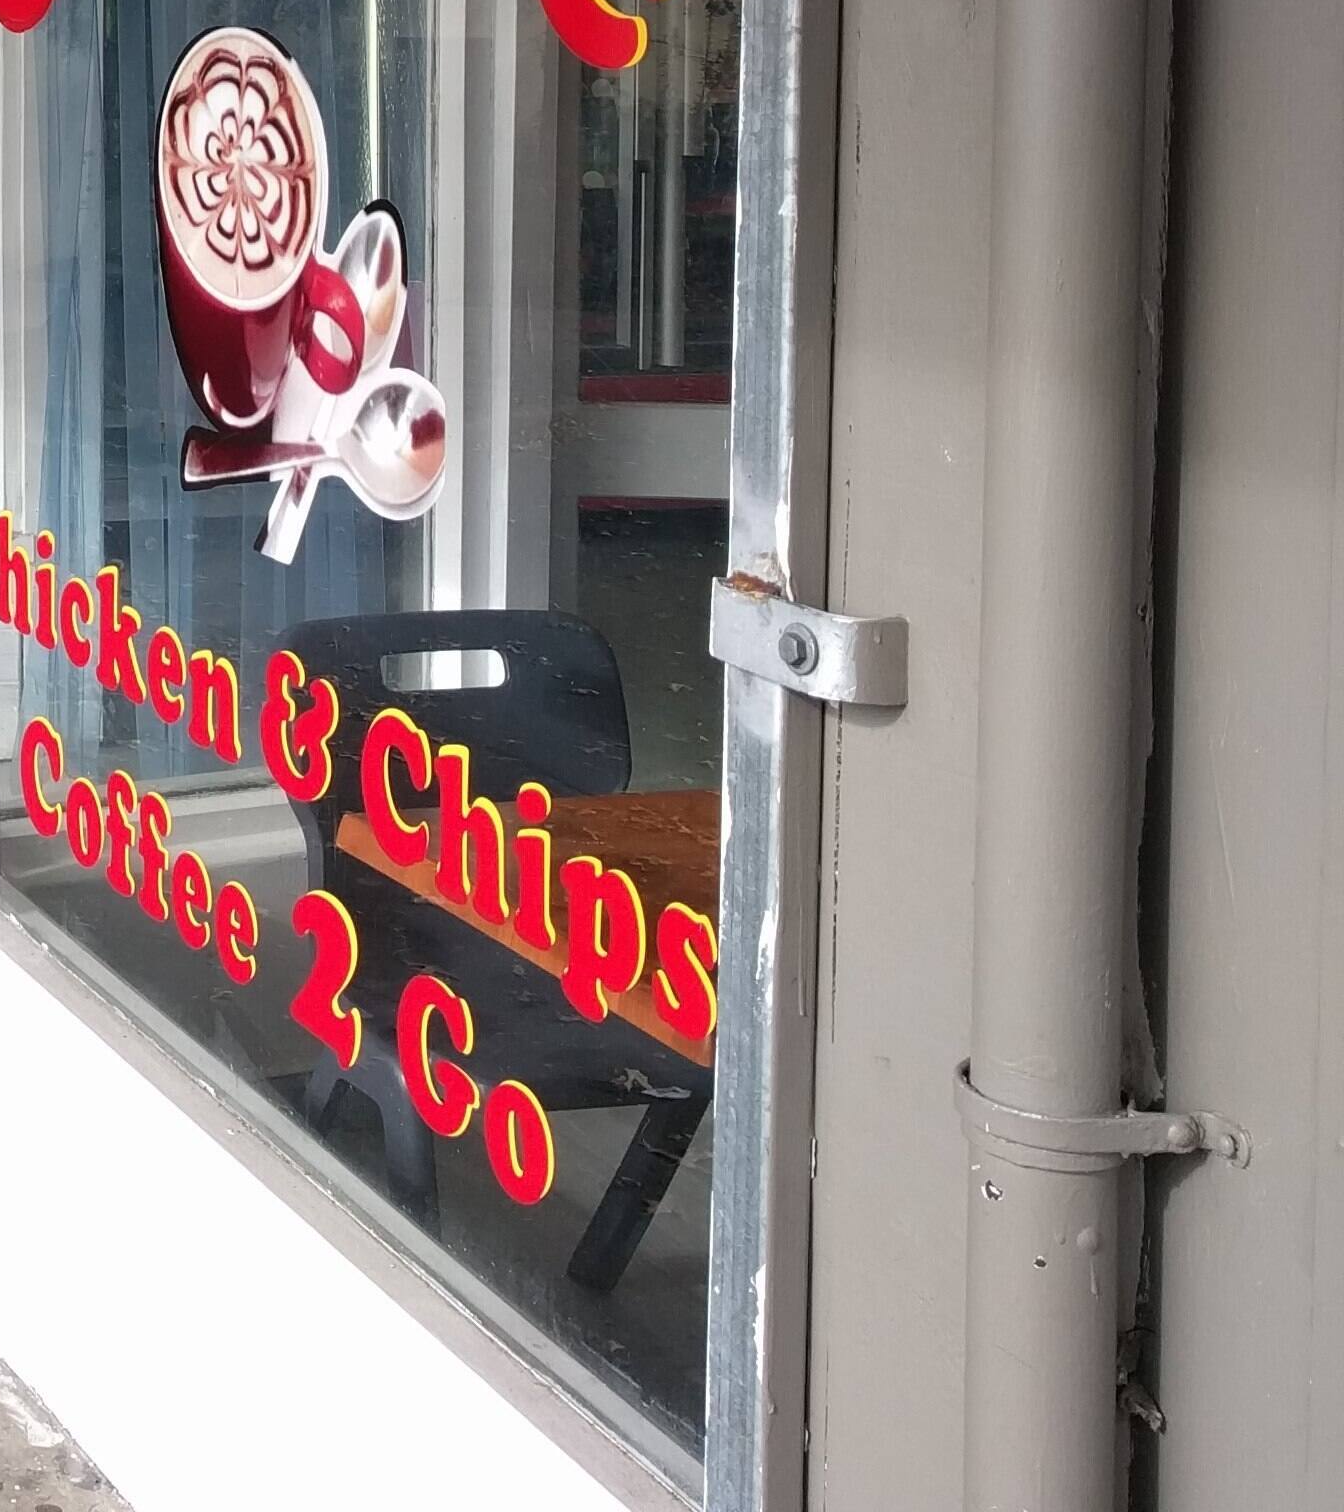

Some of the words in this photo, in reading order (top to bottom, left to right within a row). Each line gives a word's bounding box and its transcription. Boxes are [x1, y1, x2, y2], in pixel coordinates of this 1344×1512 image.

[19, 716, 260, 986] Coffee
[290, 890, 362, 1069] 2
[397, 975, 556, 1205] Go
[260, 650, 340, 803] &
[360, 707, 718, 1042] Chips
